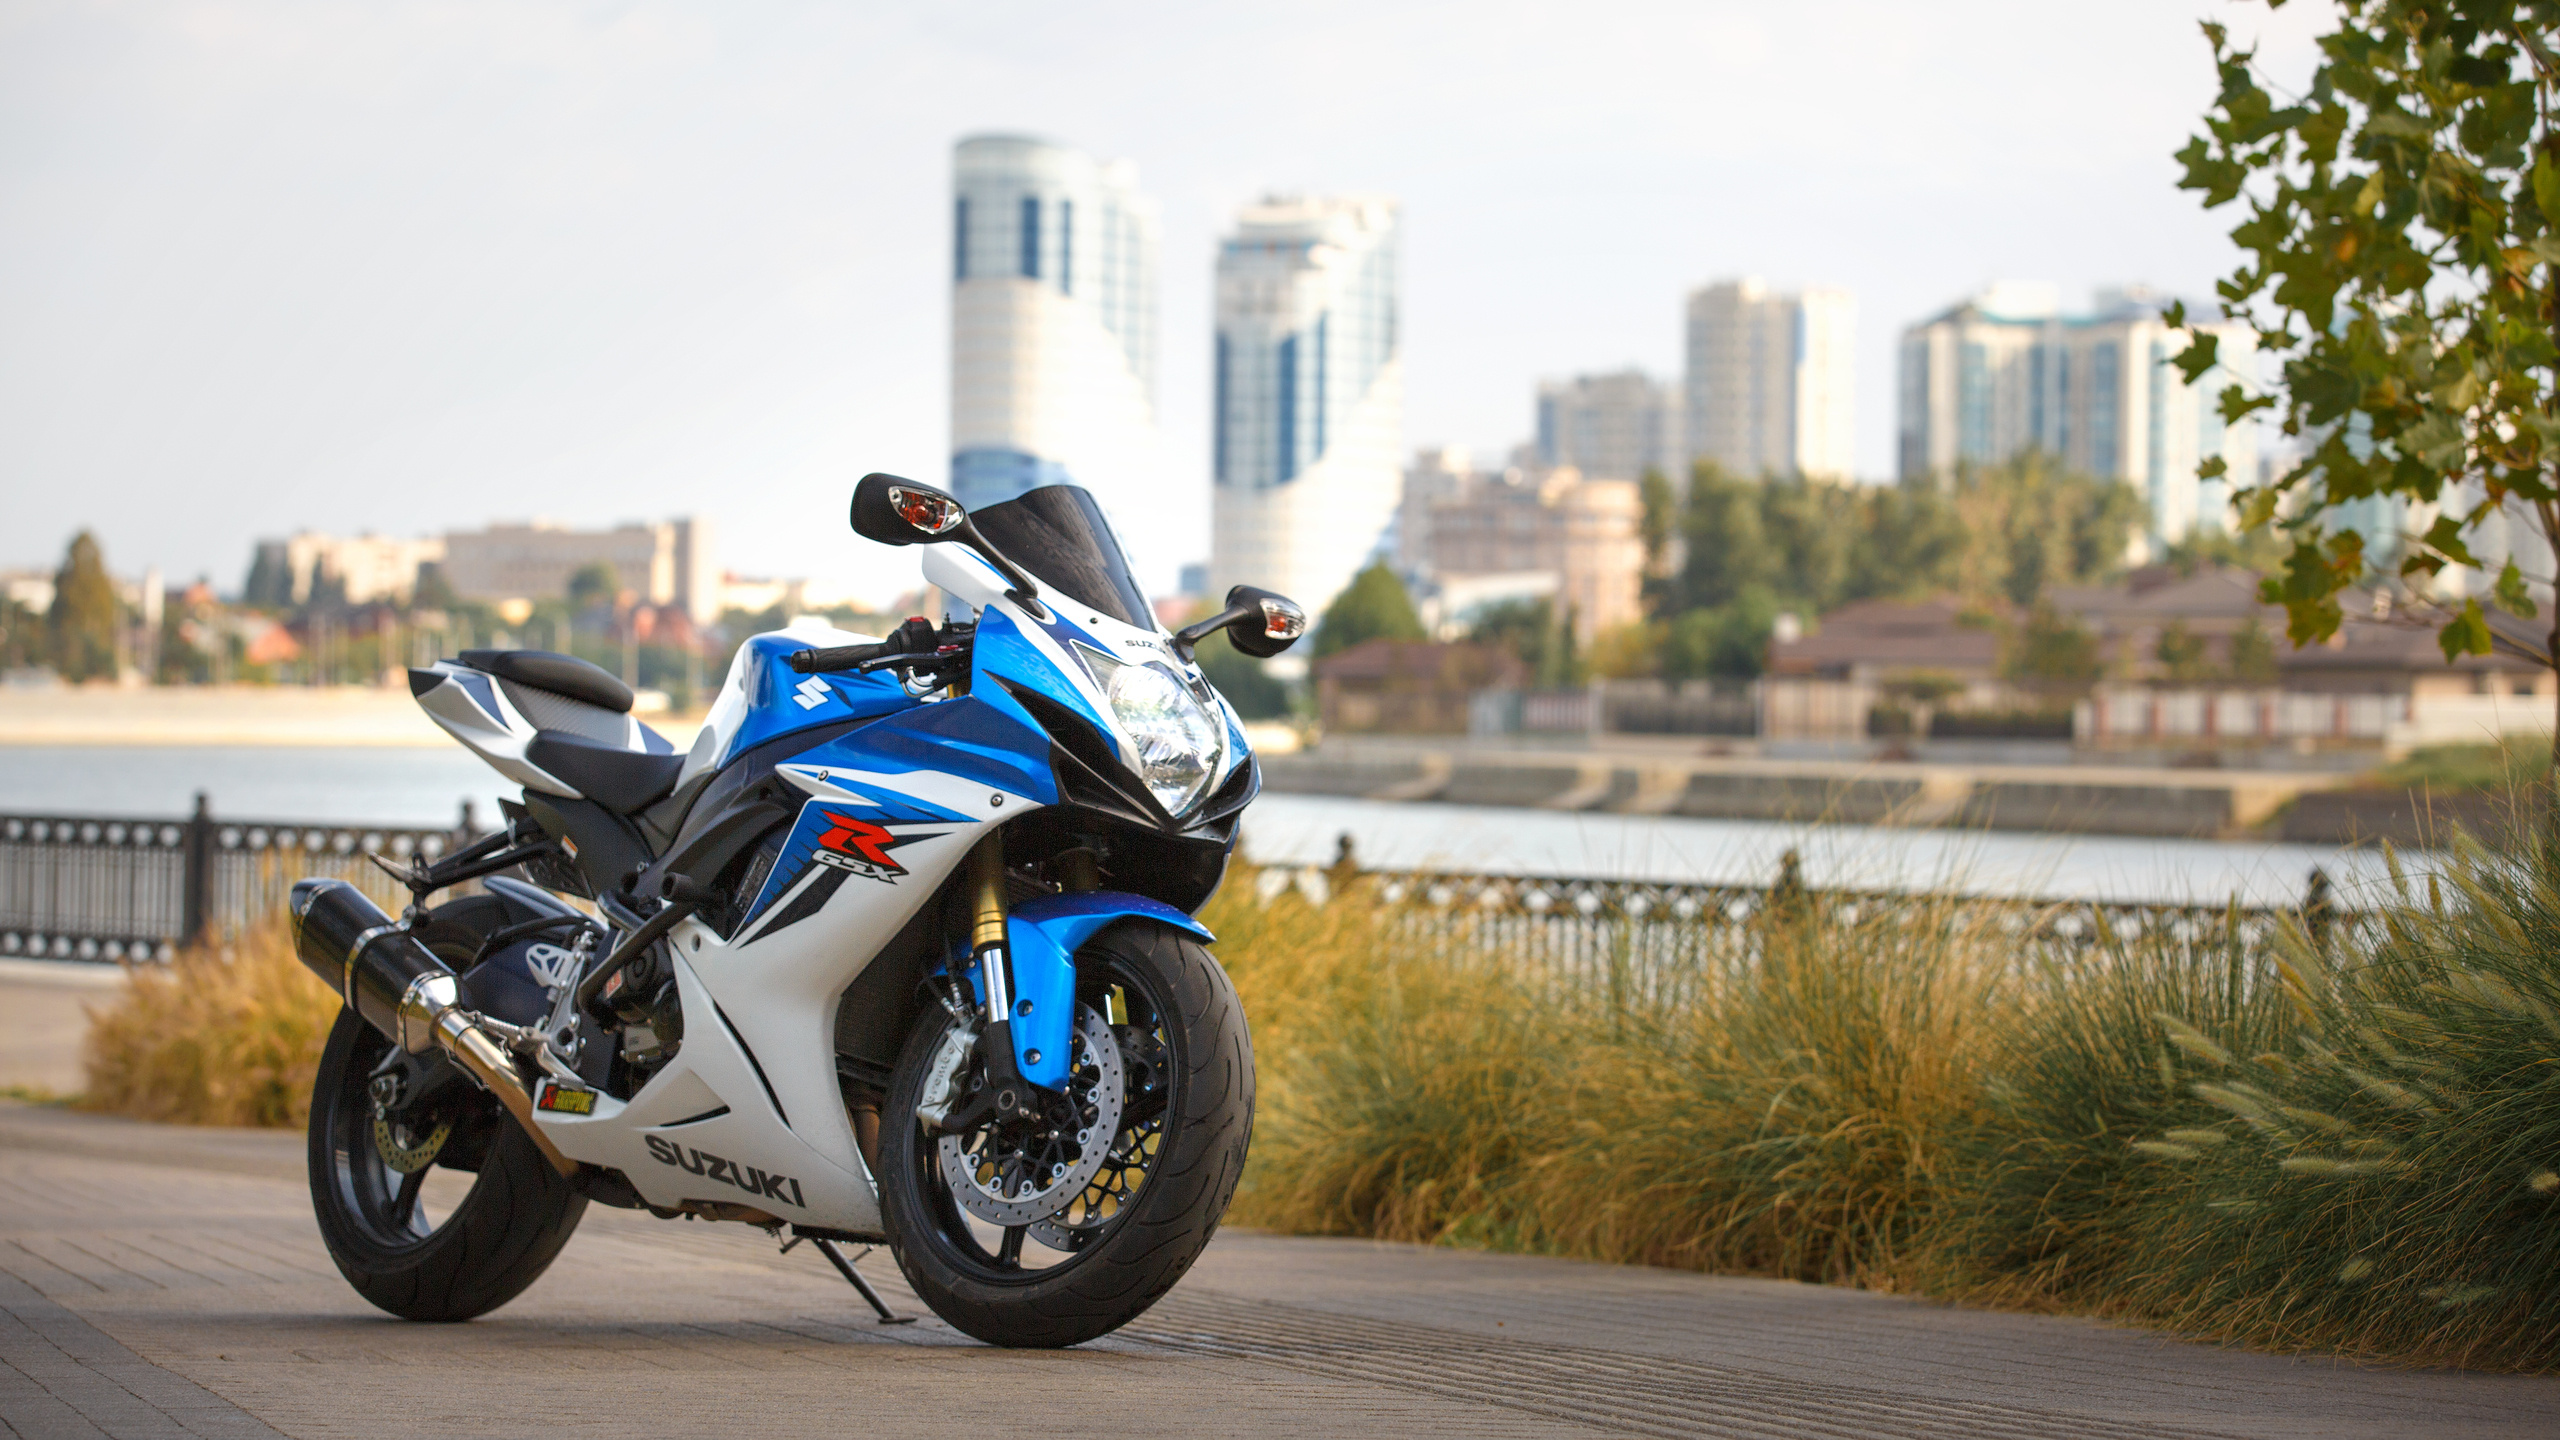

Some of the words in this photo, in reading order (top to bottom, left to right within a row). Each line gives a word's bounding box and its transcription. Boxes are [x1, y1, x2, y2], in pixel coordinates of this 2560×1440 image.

[811, 848, 902, 884] GSX
[925, 1046, 955, 1102] brembo
[644, 1134, 806, 1209] SUZUKI
